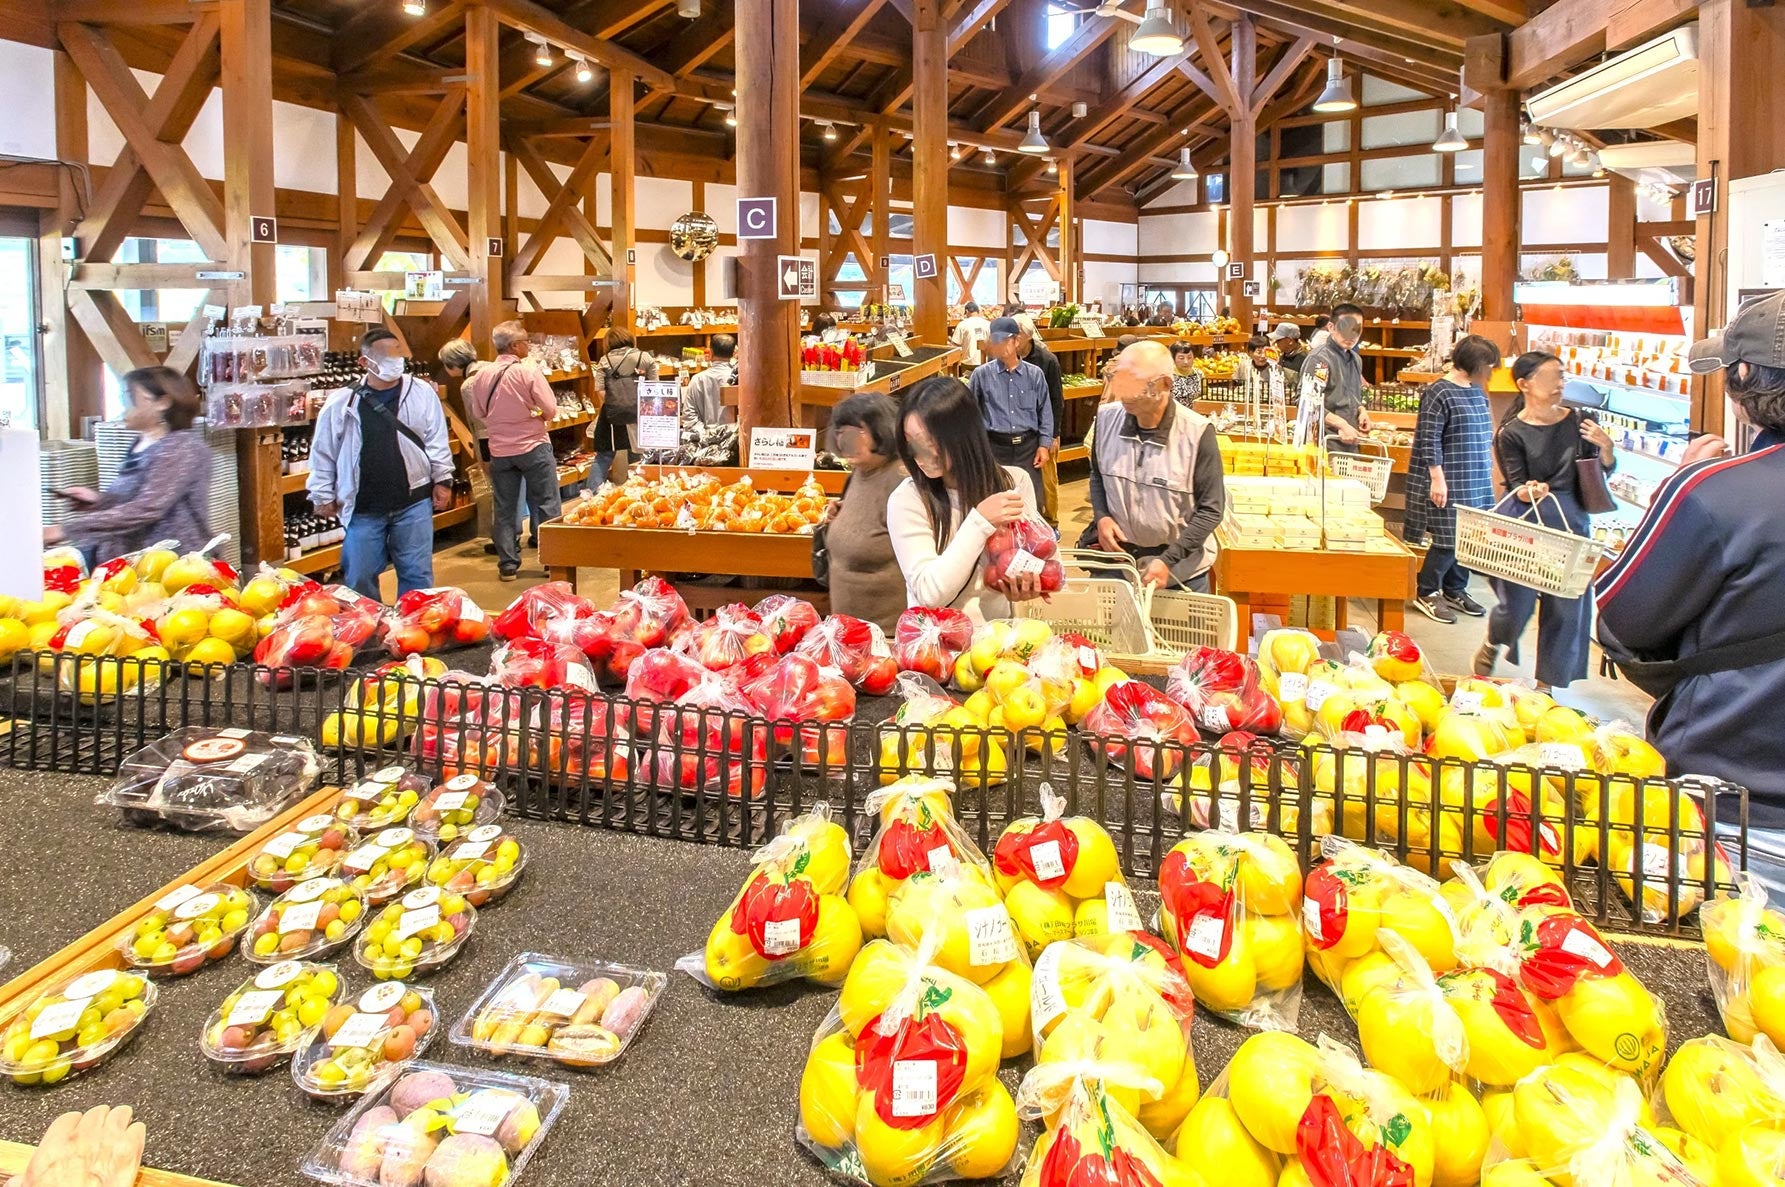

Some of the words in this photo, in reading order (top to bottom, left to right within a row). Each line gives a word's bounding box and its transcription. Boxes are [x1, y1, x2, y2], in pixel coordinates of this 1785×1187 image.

[1697, 187, 1712, 206] 17
[746, 207, 767, 230] C
[259, 222, 269, 237] 6
[492, 242, 498, 253] 7
[919, 260, 931, 273] D
[1232, 265, 1241, 275] E
[646, 387, 674, 396] さらし柿
